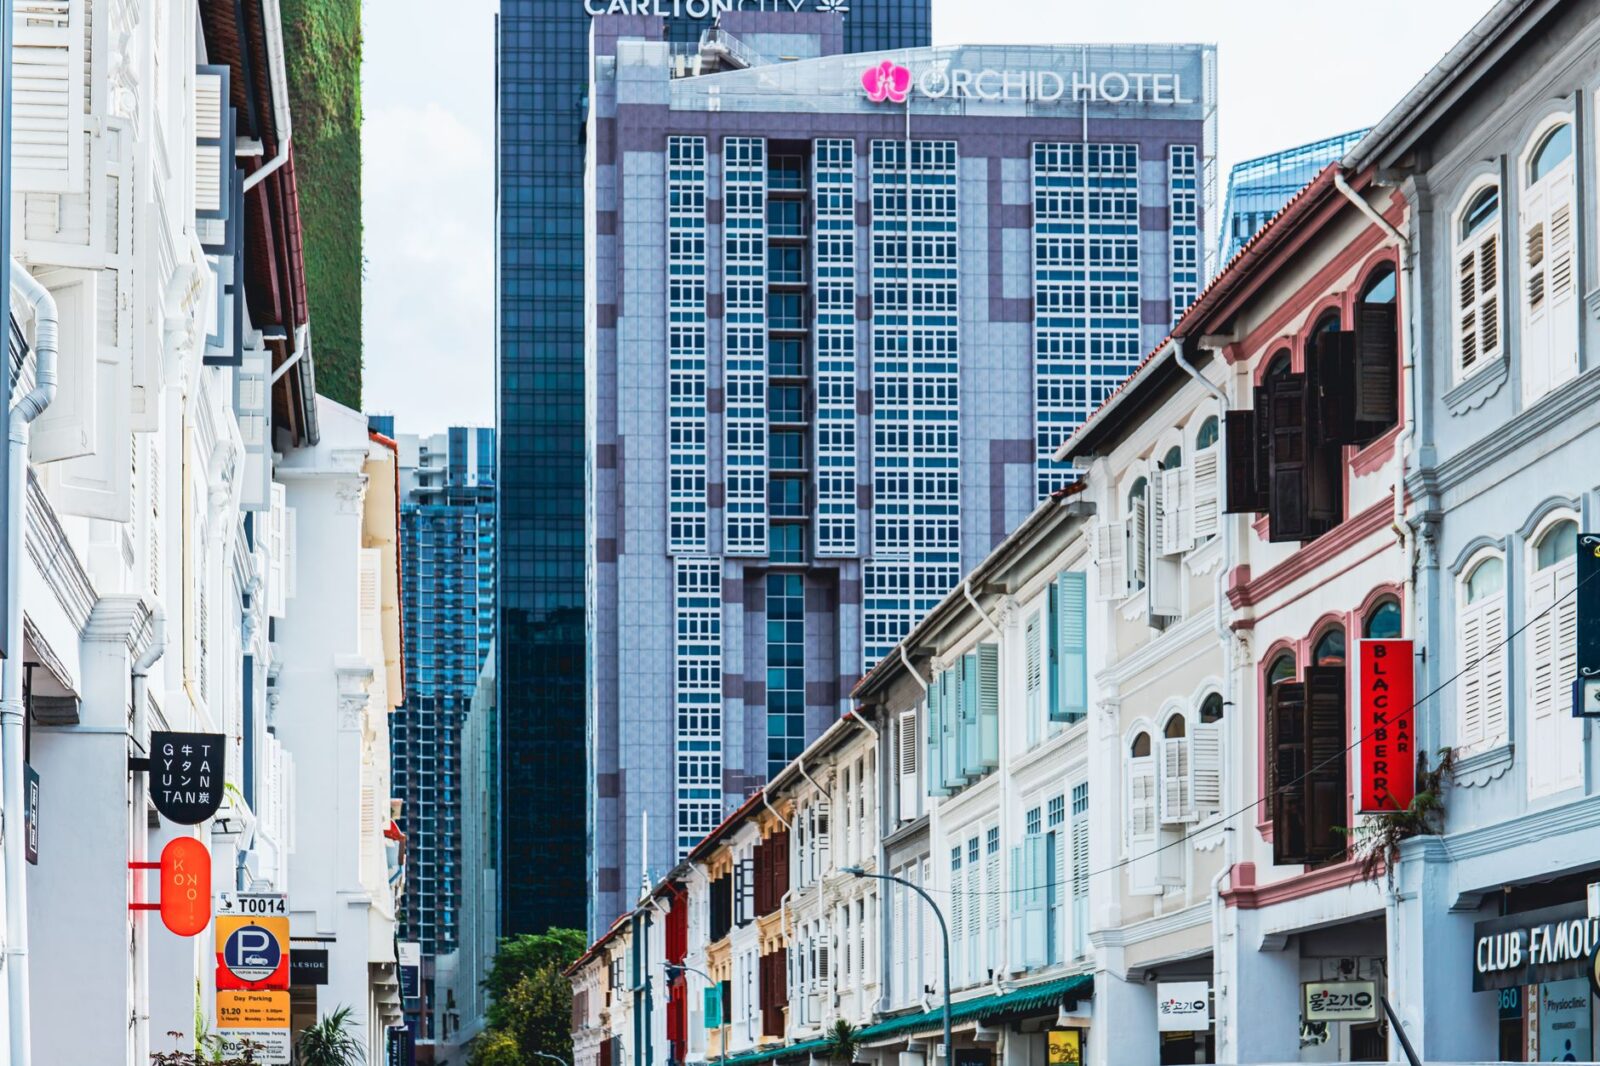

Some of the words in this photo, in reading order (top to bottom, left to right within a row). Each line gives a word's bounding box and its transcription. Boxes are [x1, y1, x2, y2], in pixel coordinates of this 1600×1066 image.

[919, 69, 1064, 101] ORCHID
[1072, 71, 1193, 104] HOTEL
[1372, 644, 1388, 808] BLACKBERRY
[1397, 719, 1408, 752] BAR
[238, 898, 286, 913] T0014
[237, 930, 270, 966] P
[1477, 931, 1521, 973] CLUB
[221, 1007, 241, 1015] $1.20
